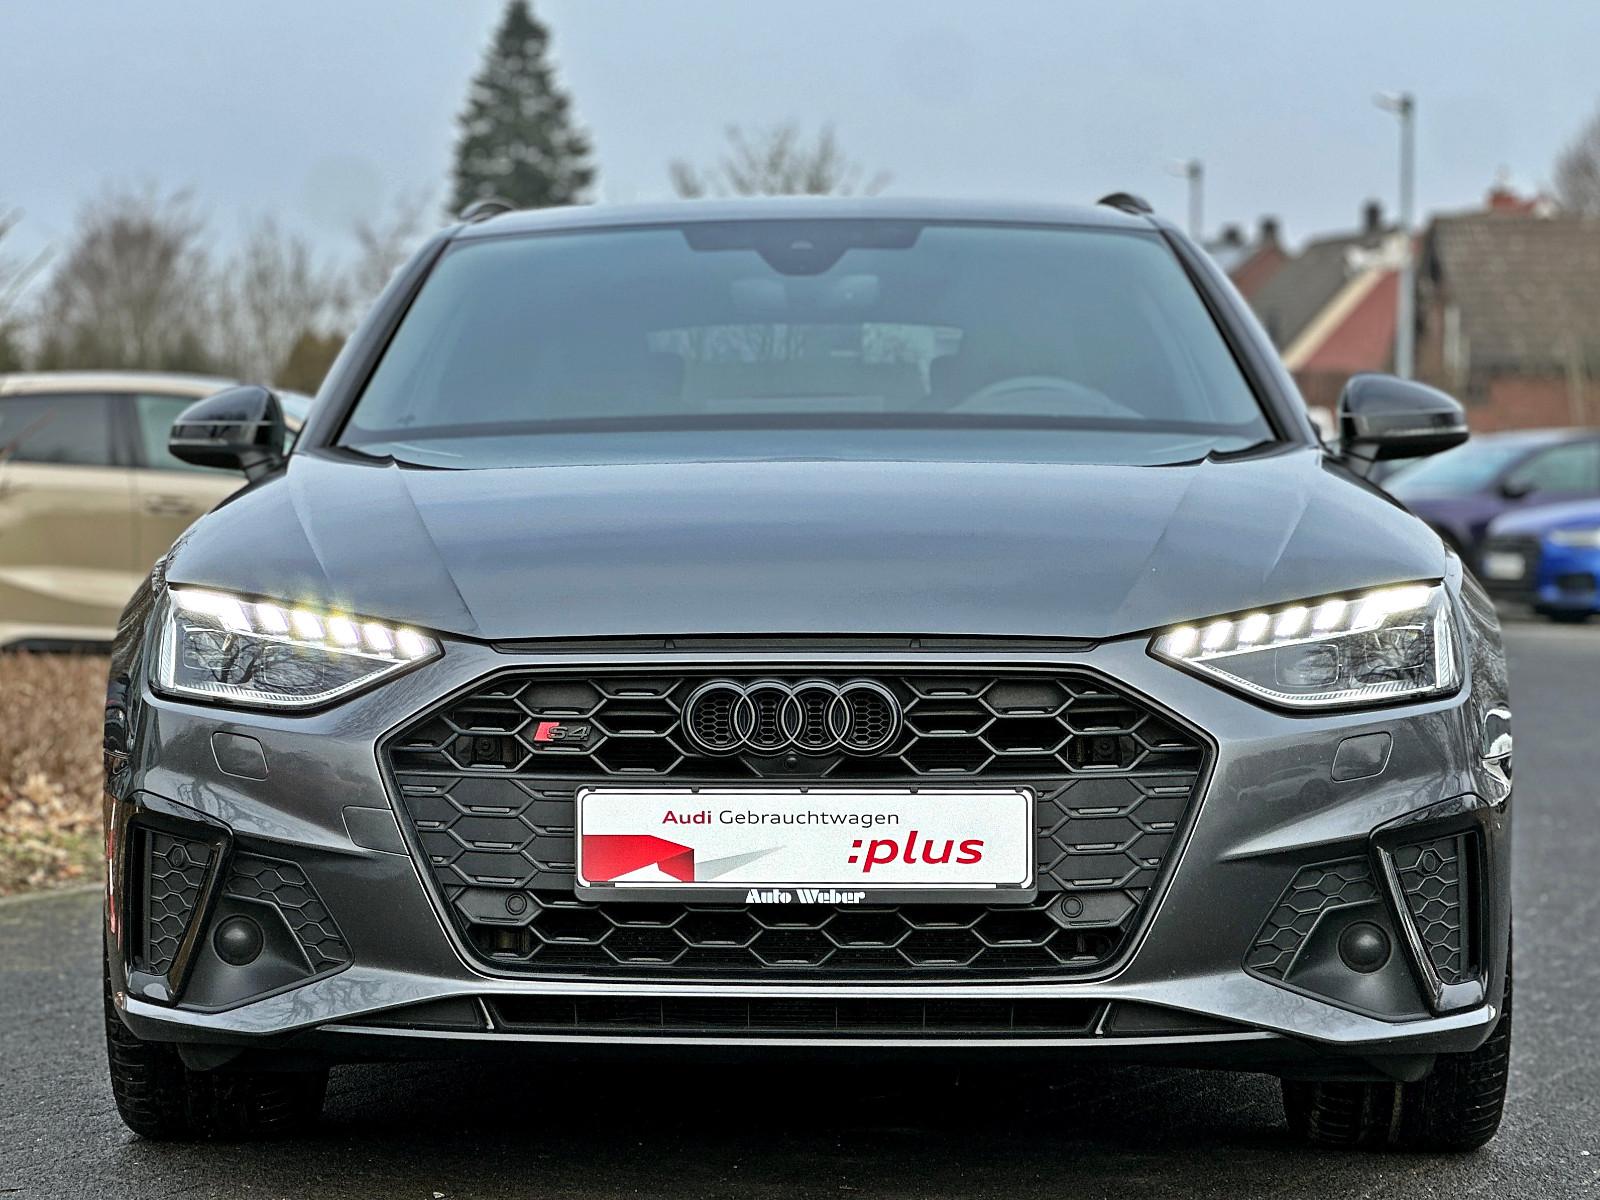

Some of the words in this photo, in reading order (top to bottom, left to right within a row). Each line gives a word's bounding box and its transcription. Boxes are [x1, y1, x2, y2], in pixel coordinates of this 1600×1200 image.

[546, 725, 592, 740] S4
[662, 810, 712, 825] Audi
[719, 810, 900, 829] Gebrauchtwagen
[848, 830, 985, 873] :plus
[745, 888, 792, 904] Auto
[796, 888, 866, 904] Weber
